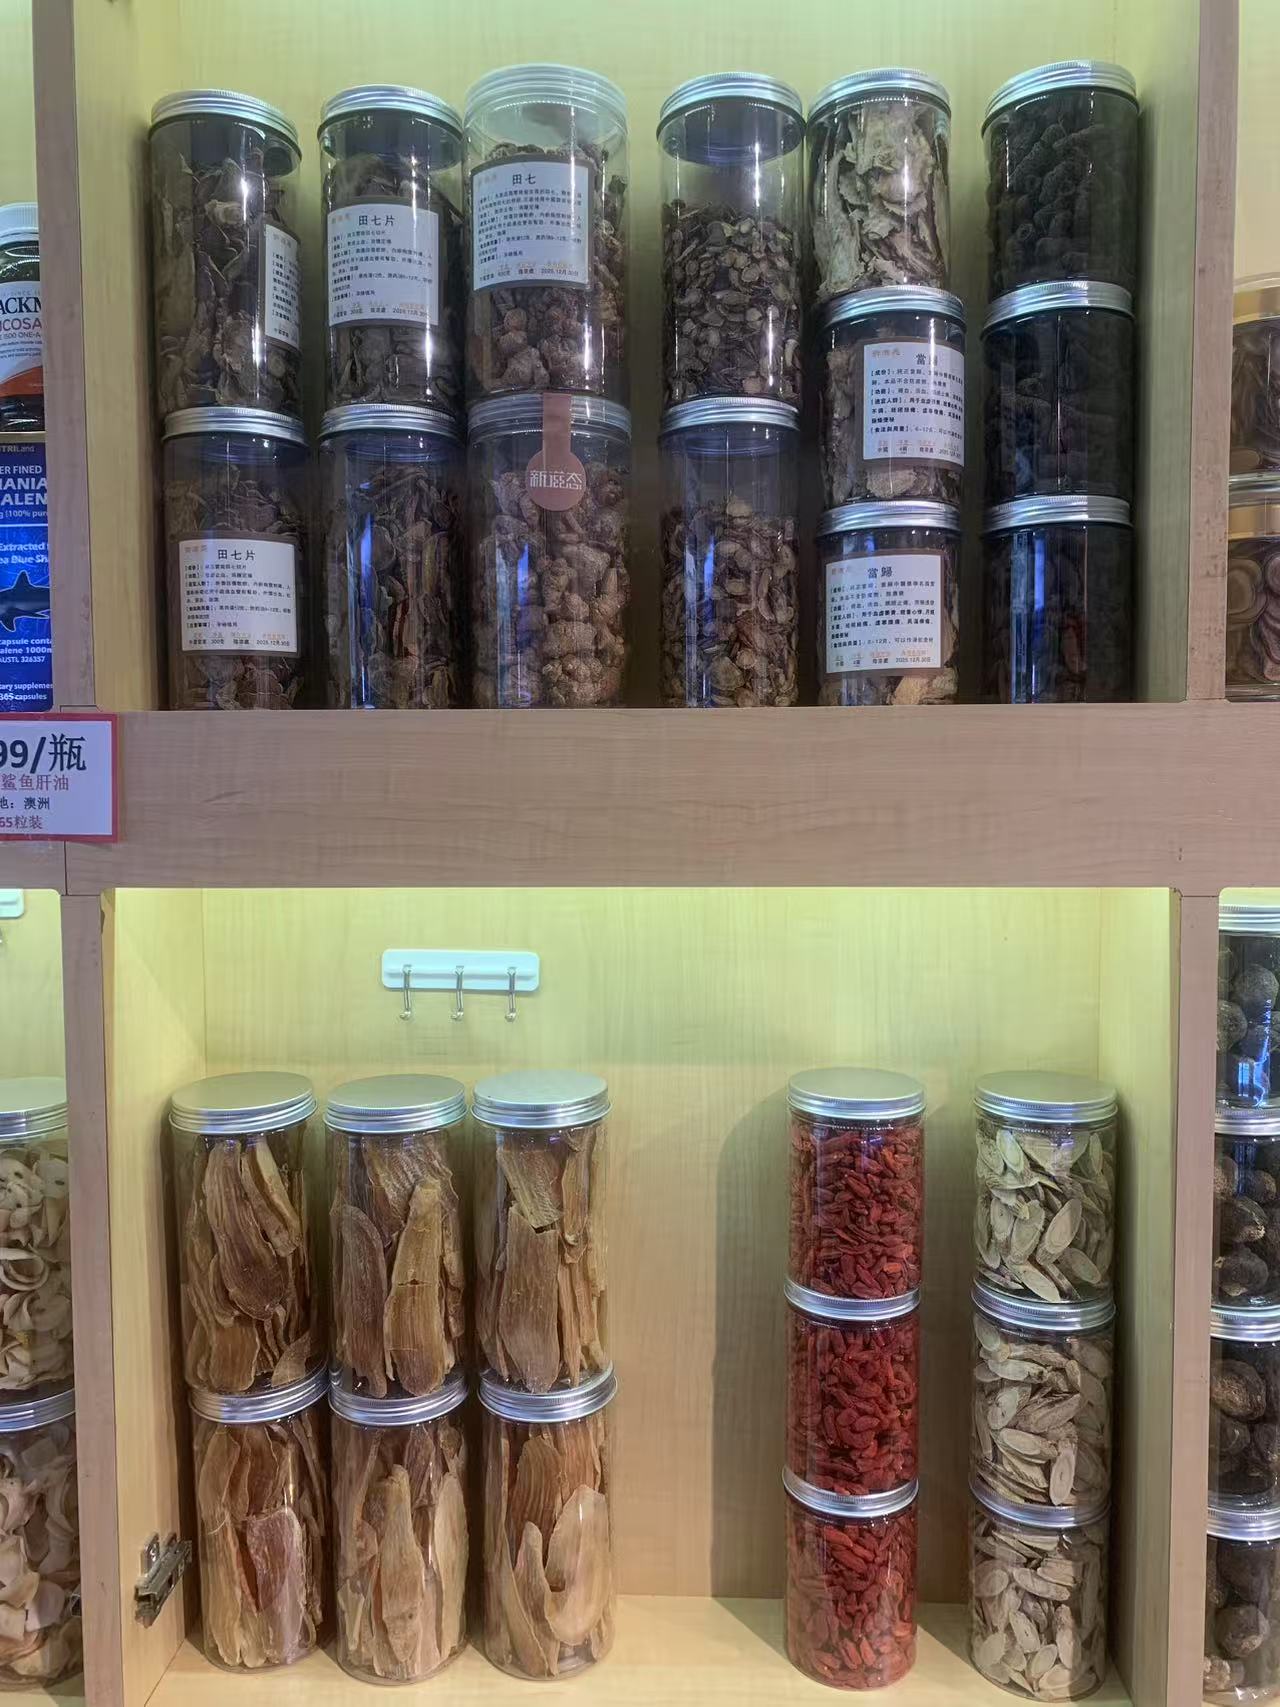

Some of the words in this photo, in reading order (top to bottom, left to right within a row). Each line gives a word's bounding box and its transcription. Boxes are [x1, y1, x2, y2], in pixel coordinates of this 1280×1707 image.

[358, 215, 395, 226] 田七片
[0, 317, 42, 332] COSA
[13, 465, 43, 474] FINED
[218, 549, 256, 560] 田七片
